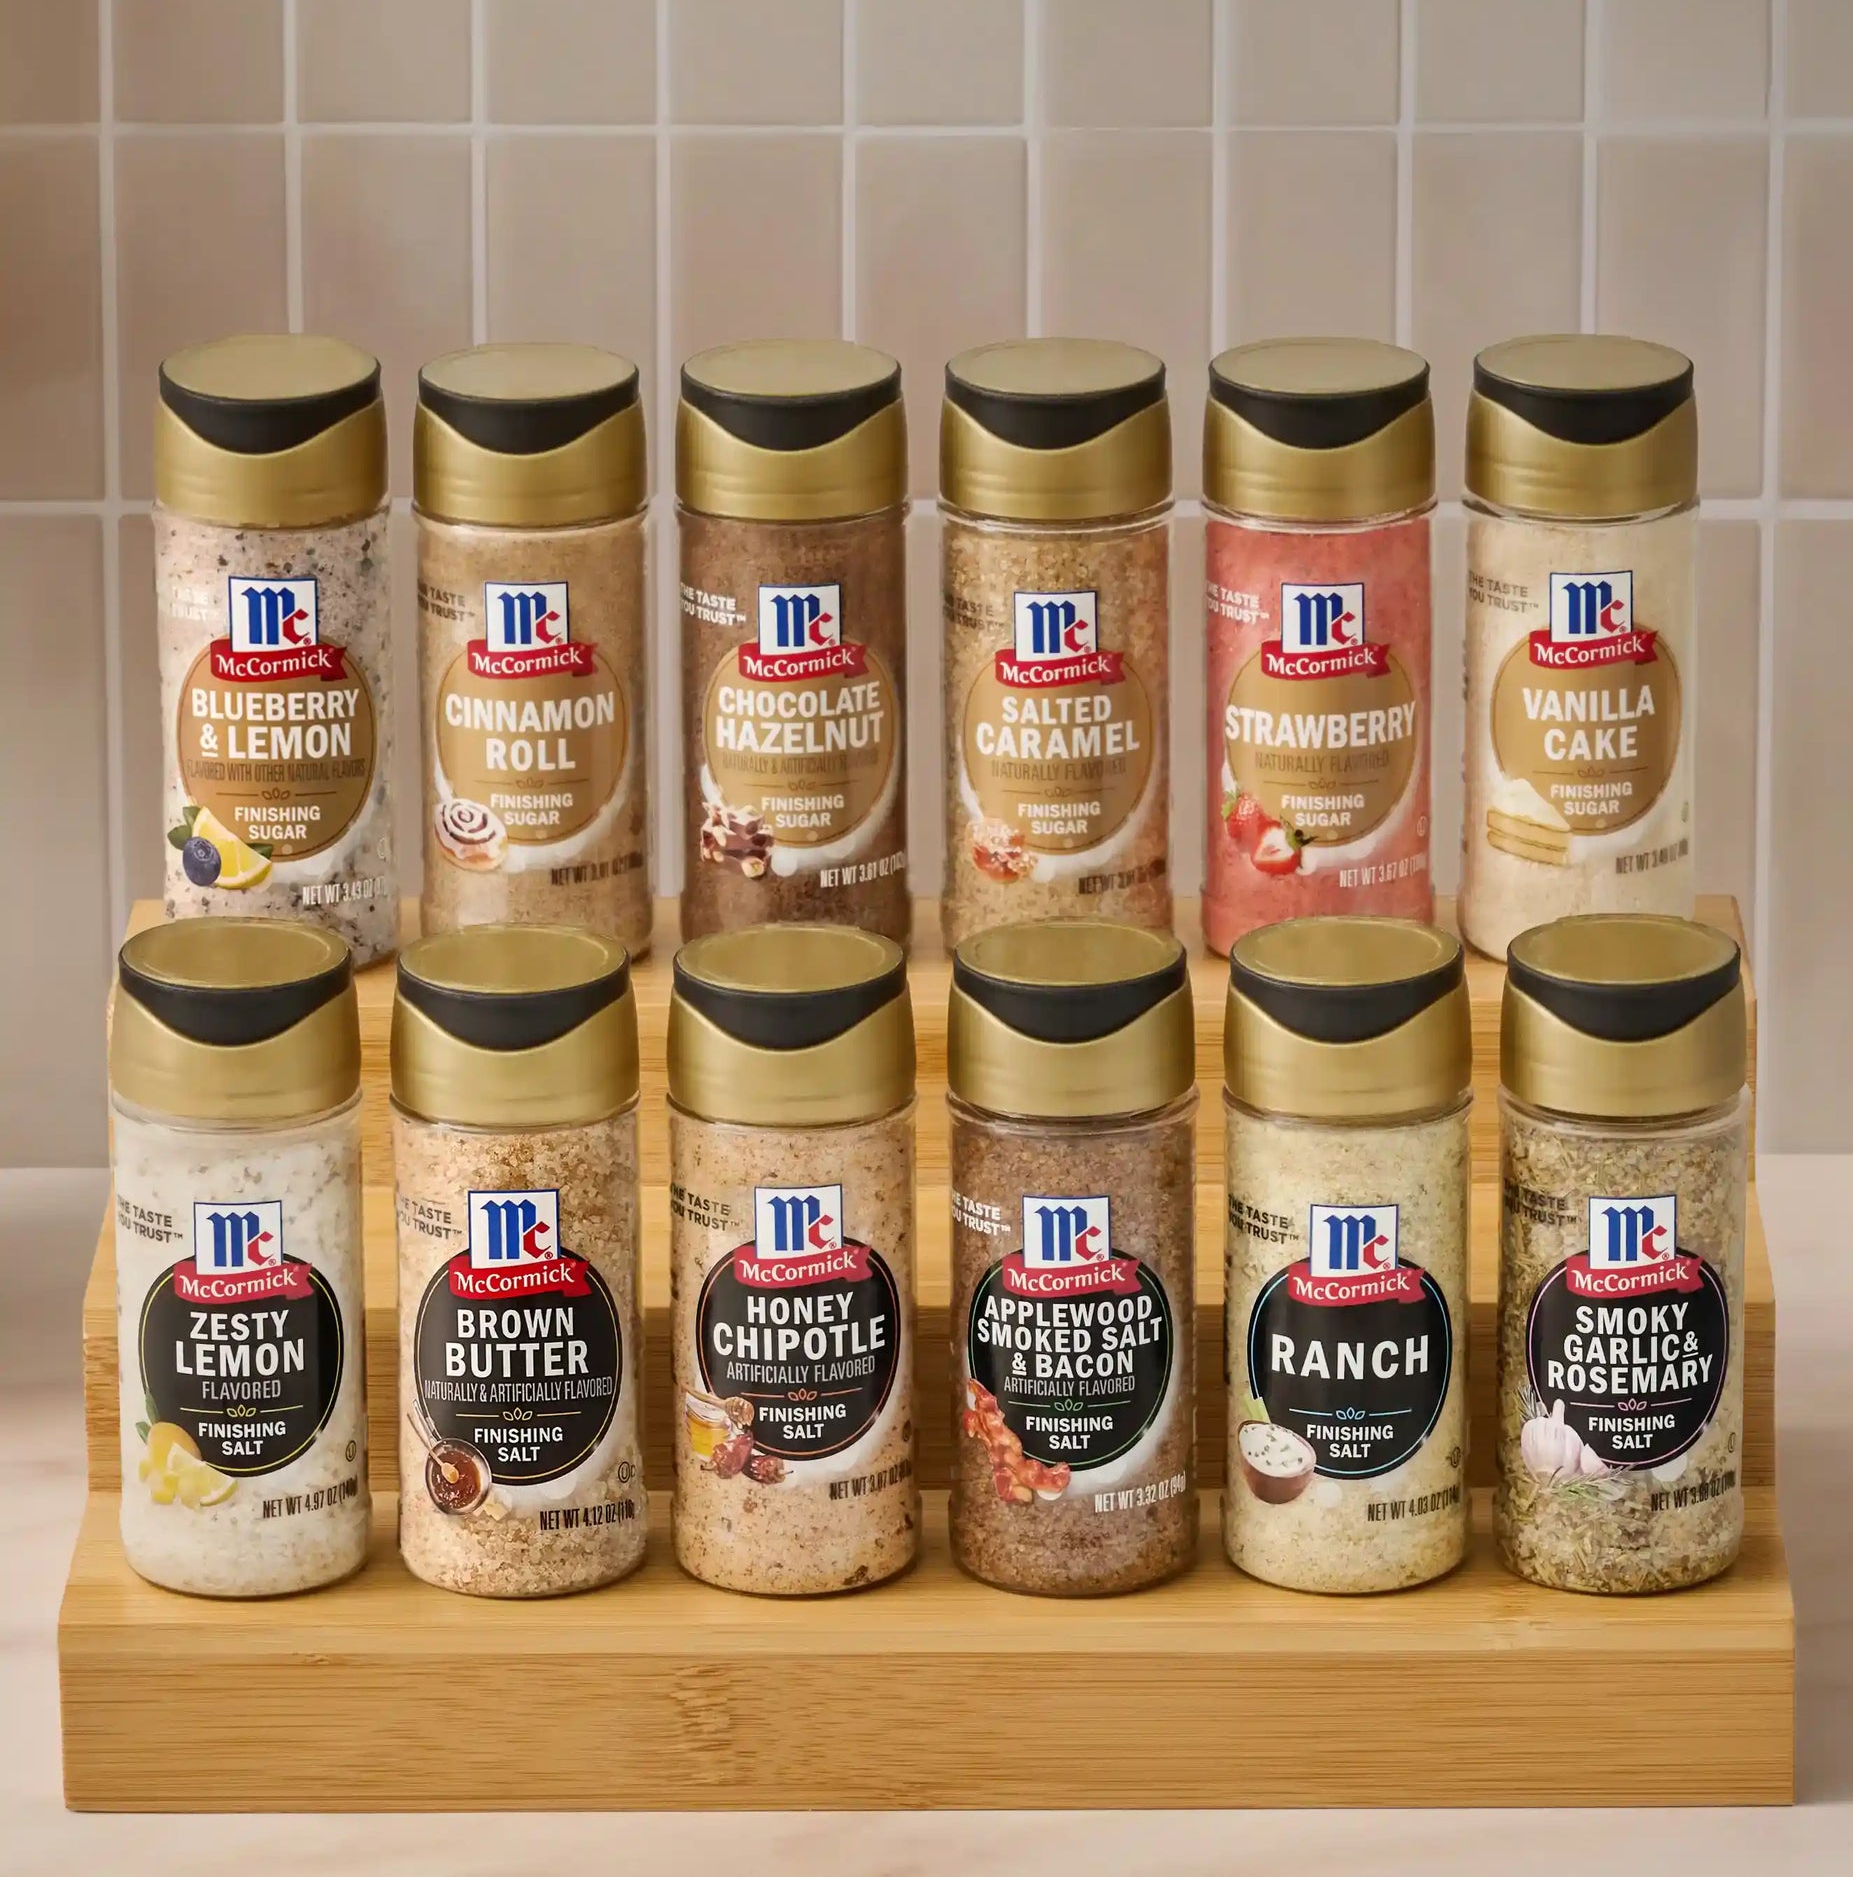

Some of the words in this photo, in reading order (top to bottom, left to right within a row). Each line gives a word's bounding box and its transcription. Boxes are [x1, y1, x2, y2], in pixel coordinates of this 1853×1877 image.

[1221, 587, 1259, 608] TASTE
[1487, 578, 1528, 597] TASTE
[696, 591, 736, 611] TASTE
[216, 649, 331, 676] McCormick
[472, 646, 582, 674] McCormick
[1266, 648, 1376, 675] McCormick
[1534, 635, 1645, 664] McCormick
[743, 650, 854, 677] McCormick
[1000, 656, 1110, 683] McCormick
[192, 688, 359, 720] BLUEBERRY
[445, 692, 615, 733] CINNAMON
[718, 681, 880, 720] CHOCOLATE
[1002, 696, 1111, 724] SALTED
[1521, 685, 1655, 722] VANILLA
[716, 711, 884, 754] HAZELNUT
[1225, 701, 1417, 749] STRAWBERRY
[200, 723, 219, 757] &
[228, 723, 351, 759] LEMON
[977, 722, 1140, 760] CARAMEL
[1543, 726, 1638, 761] CAKE
[485, 738, 576, 771] ROLL
[1255, 752, 1324, 772] NATURALLY
[227, 761, 252, 782] WITH
[254, 760, 285, 782] OTHER
[288, 760, 330, 782] NATURAL
[992, 760, 1059, 781] NATURALLY
[490, 793, 573, 809] FINISHING
[761, 795, 844, 811] FINISHING
[1281, 795, 1364, 809] FINISHING
[1550, 782, 1632, 799] FINISHING
[234, 805, 321, 822] FINISHING
[504, 811, 560, 825] SUGAR
[776, 812, 831, 827] SUGAR
[1018, 802, 1101, 818] FINISHING
[1295, 811, 1351, 826] SUGAR
[1564, 801, 1619, 815] SUGAR
[248, 825, 307, 840] SUGAR
[1032, 820, 1087, 834] SUGAR
[820, 869, 840, 888] NET
[842, 865, 858, 885] WT
[1339, 868, 1358, 888] NET
[1362, 866, 1376, 885] WT
[1378, 862, 1397, 883] 3.67
[303, 885, 321, 905] NET
[324, 884, 341, 904] WT
[132, 1205, 172, 1227] TASTE
[412, 1201, 451, 1224] TASTE
[687, 1192, 731, 1217] TASTE
[962, 1196, 1001, 1220] TASTE
[1246, 1206, 1288, 1229] TASTE
[454, 1262, 573, 1293] McCormick
[739, 1251, 854, 1282] McCormick
[1008, 1263, 1125, 1291] McCormick
[1574, 1262, 1688, 1292] McCormick
[179, 1269, 297, 1299] McCormick
[1293, 1271, 1409, 1301] McCormick
[747, 1291, 854, 1324] HONEY
[984, 1295, 1153, 1328] APPLEWOOD
[1576, 1302, 1689, 1336] SMOKY
[190, 1309, 289, 1341] ZESTY
[457, 1306, 574, 1338] BROWN
[978, 1318, 1091, 1353] SMOKED
[1102, 1317, 1162, 1350] SALT
[713, 1314, 885, 1361] CHIPOTLE
[175, 1339, 305, 1378] LEMON
[445, 1340, 589, 1378] BUTTER
[727, 1360, 809, 1384] ARTIFICIALLY
[814, 1355, 875, 1382] FLAVORED
[1011, 1353, 1027, 1376] &
[1035, 1350, 1133, 1378] BACON
[1271, 1333, 1429, 1380] RANCH
[1004, 1376, 1074, 1396] ARTIFICIALLY
[1079, 1375, 1135, 1395] FLAVORED
[1547, 1354, 1713, 1395] ROSEMARY
[202, 1380, 281, 1400] FLAVORED
[424, 1380, 478, 1402] NATURALLY
[488, 1381, 561, 1403] ARTIFICIALLY
[564, 1376, 613, 1401] FLAVORED
[759, 1403, 846, 1422] FINISHING
[1026, 1415, 1113, 1433] FINISHING
[1588, 1414, 1675, 1432] FINISHING
[198, 1421, 286, 1439] FINISHING
[474, 1427, 563, 1443] FINISHING
[783, 1423, 824, 1439] SALT
[1049, 1434, 1090, 1450] SALT
[1306, 1424, 1394, 1441] FINISHING
[1612, 1434, 1653, 1450] SALT
[221, 1441, 263, 1455] SALT
[498, 1446, 540, 1462] SALT
[1329, 1444, 1371, 1459] SALT
[829, 1480, 849, 1500] NET
[852, 1478, 867, 1497] WT
[1094, 1493, 1114, 1513] NET
[1117, 1490, 1134, 1510] WT
[1136, 1485, 1156, 1506] 3.32
[1159, 1482, 1169, 1501] OZ
[1651, 1491, 1670, 1512] NET
[1673, 1486, 1689, 1508] WT
[263, 1500, 281, 1519] NET
[284, 1496, 300, 1516] WT
[305, 1492, 324, 1512] 4.97
[327, 1487, 337, 1506] OZ
[1367, 1501, 1387, 1522] NET
[1390, 1498, 1406, 1519] WT
[1409, 1496, 1427, 1517] 4.03
[1430, 1493, 1440, 1512] OZ
[540, 1510, 559, 1530] NET
[562, 1508, 580, 1529] WT
[582, 1506, 602, 1527] 4.12
[605, 1503, 615, 1523] OZ
